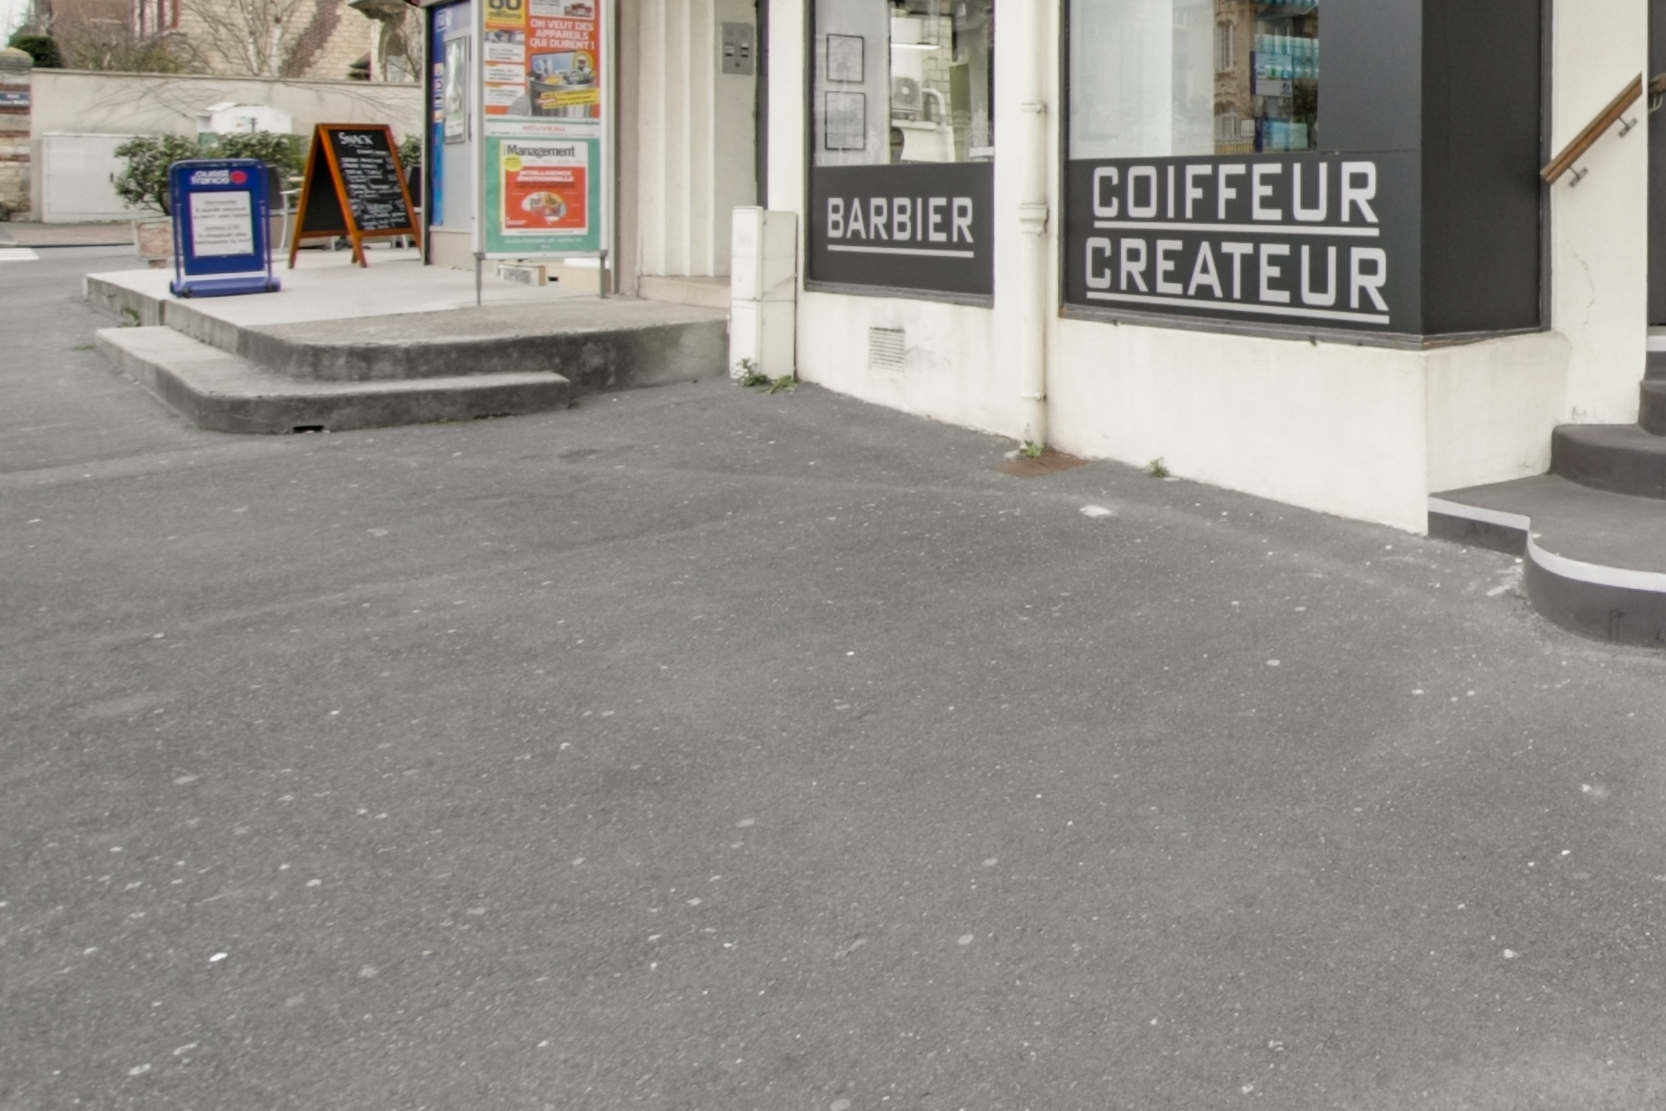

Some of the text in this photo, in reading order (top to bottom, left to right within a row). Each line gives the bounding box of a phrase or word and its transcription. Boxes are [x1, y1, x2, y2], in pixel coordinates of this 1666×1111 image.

[530, 19, 546, 28] ON
[547, 20, 573, 29] VEUT
[576, 21, 594, 30] DES
[535, 30, 589, 40] APPAREILS
[530, 38, 548, 48] QUI
[549, 39, 589, 49] DURENT
[506, 144, 576, 158] Management
[1093, 161, 1379, 223] COIFFEUR
[827, 197, 974, 243] BARBIER
[1085, 236, 1389, 311] CREATEUR
